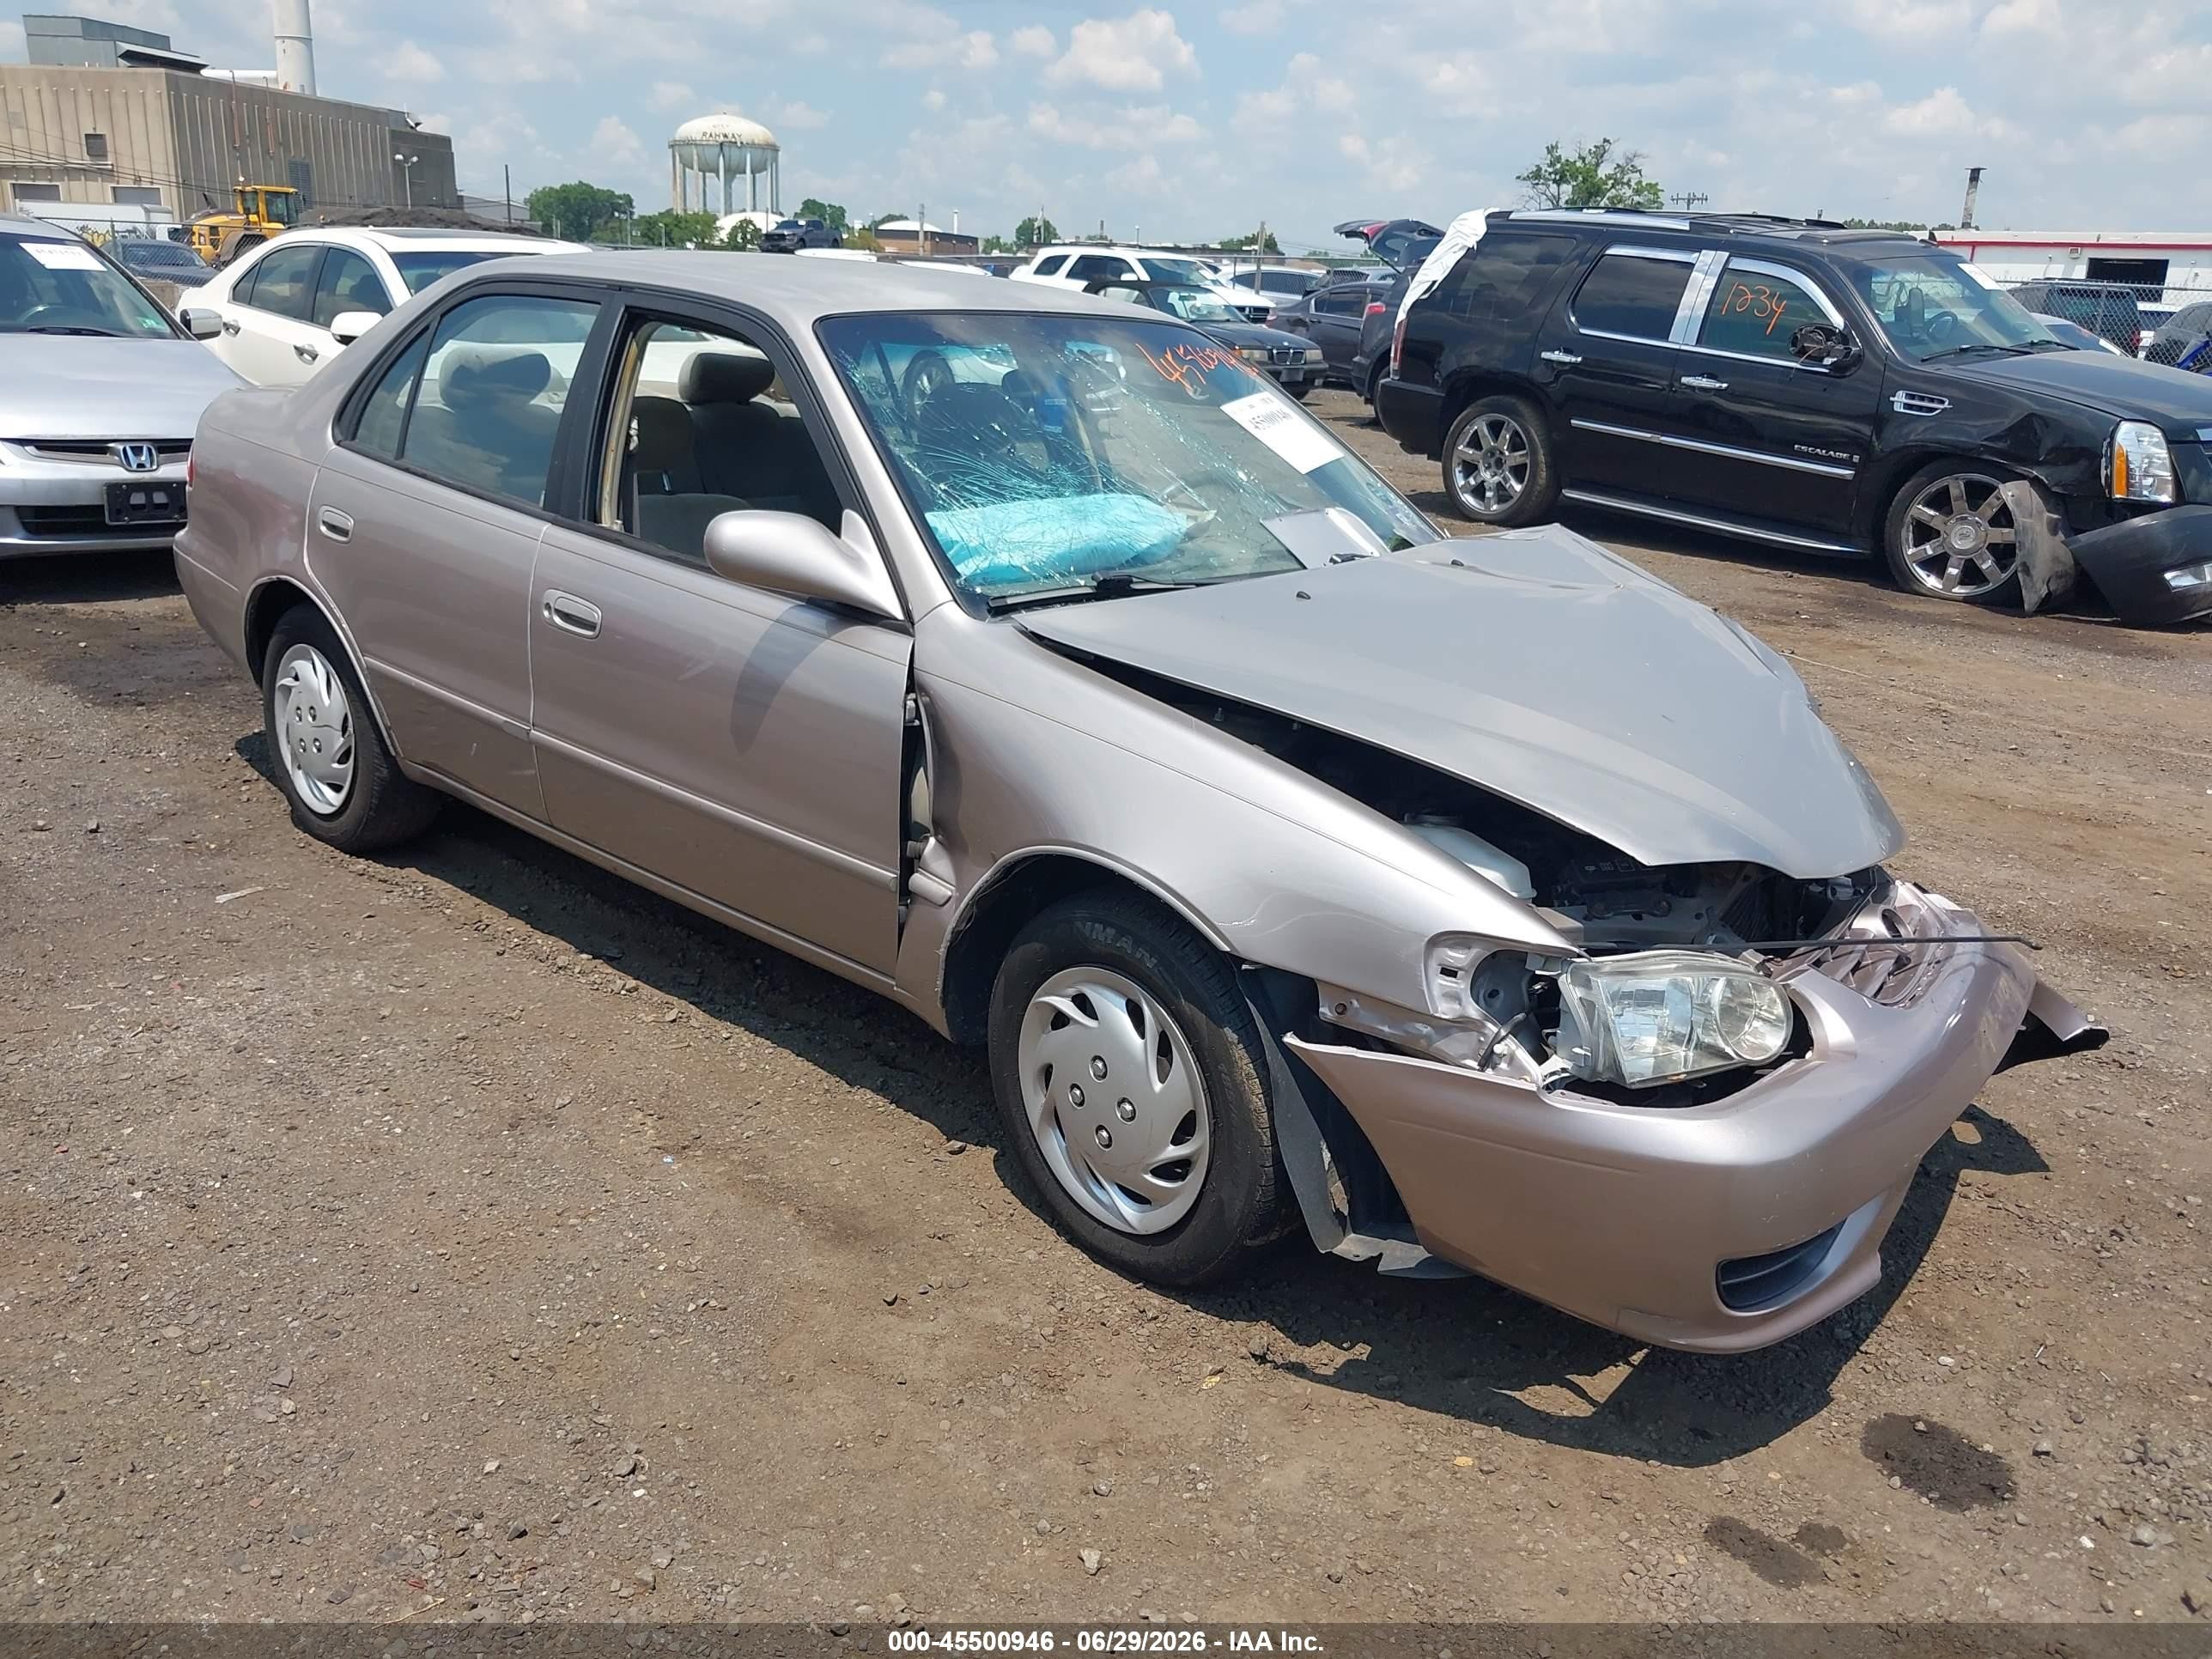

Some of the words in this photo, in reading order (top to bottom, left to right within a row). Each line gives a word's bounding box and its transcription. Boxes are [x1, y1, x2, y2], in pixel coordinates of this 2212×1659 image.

[702, 131, 743, 141] RAHWAY
[1722, 282, 1787, 336] 1234
[1794, 444, 1850, 460] ESCALADE
